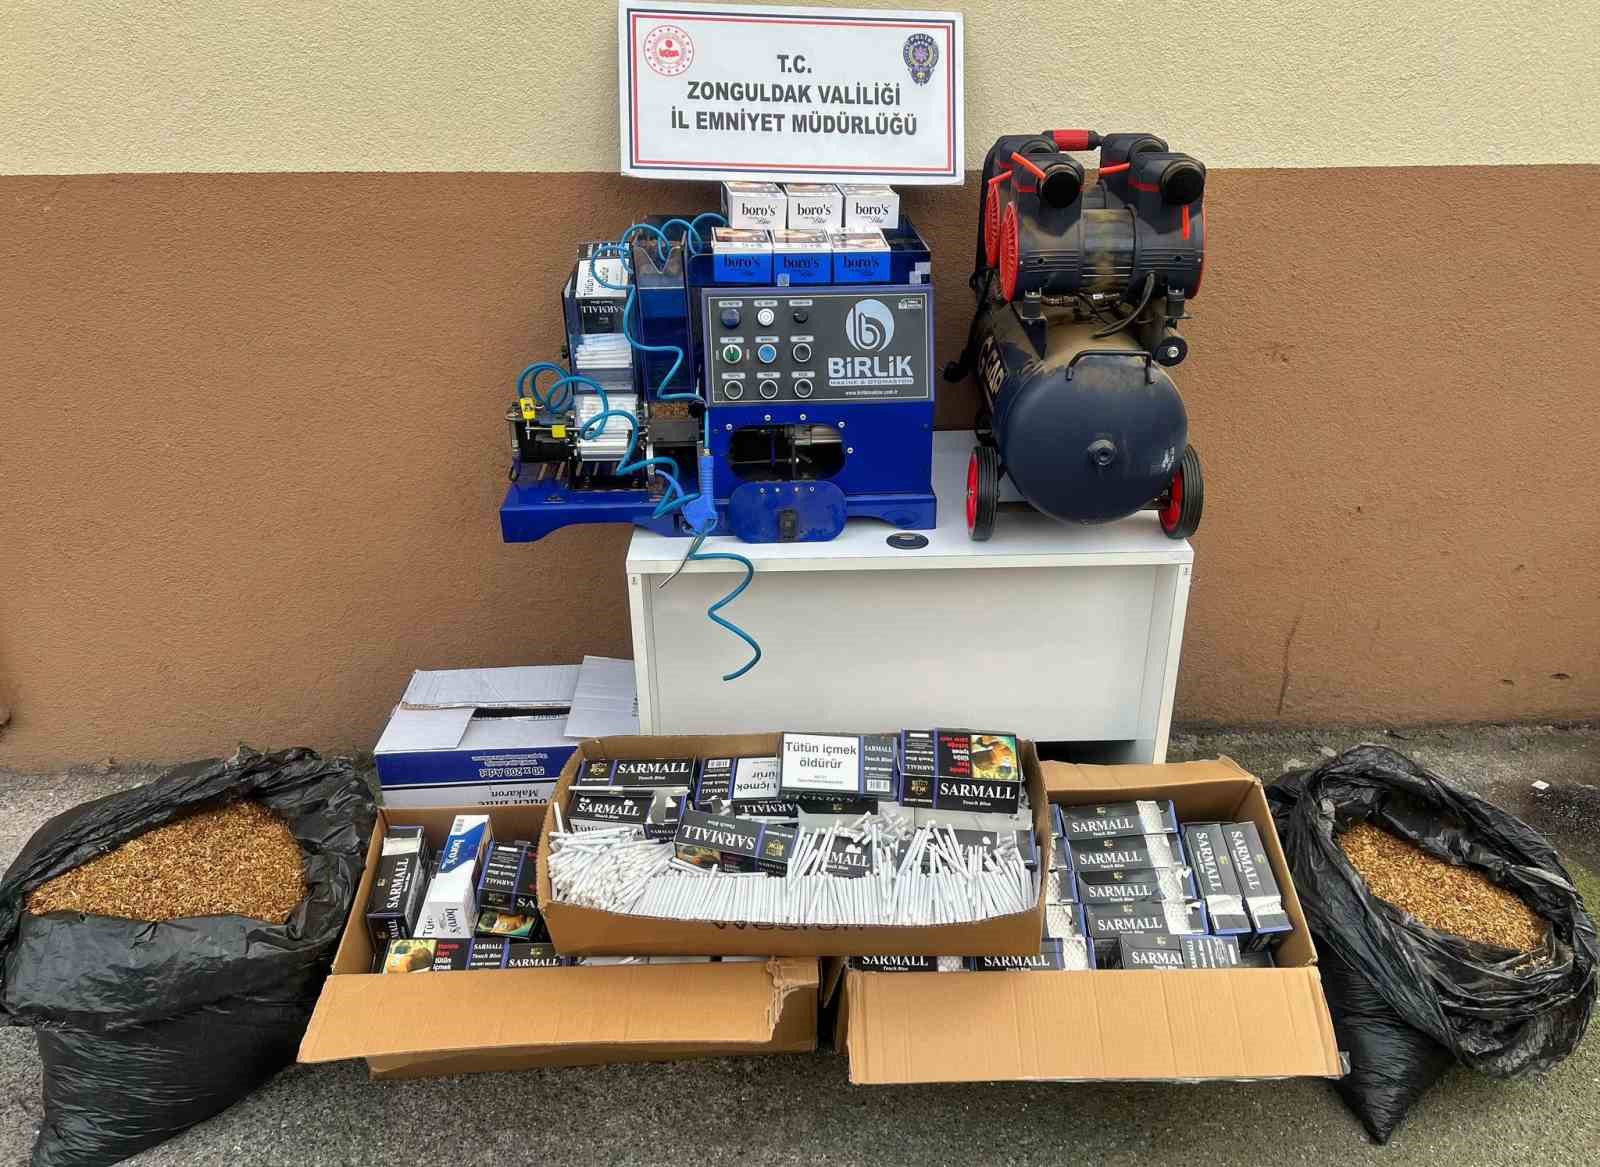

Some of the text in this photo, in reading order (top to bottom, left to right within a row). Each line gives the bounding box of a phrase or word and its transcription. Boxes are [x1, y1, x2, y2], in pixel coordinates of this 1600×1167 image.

[777, 54, 812, 74] T.C.
[687, 81, 901, 106] ZONGULDAK VALİLİĞİ
[671, 106, 917, 136] İL EMNİYET MÜDÜRLÜĞÜ
[741, 203, 776, 216] boro's
[797, 203, 831, 216] boro's
[855, 202, 889, 216] boro's
[724, 255, 761, 268] boro's
[783, 255, 820, 269] boro's
[843, 255, 880, 268] boro's
[785, 741, 857, 757] Tütün içmek
[617, 762, 689, 774] SARMALL
[799, 757, 843, 769] öldürür
[478, 768, 503, 777] Adet
[503, 767, 522, 776] 200
[490, 788, 538, 798] Makaron
[940, 782, 1016, 800] SARMALL
[577, 802, 641, 816] SARMALL
[1072, 818, 1134, 833] SARMALL
[681, 824, 756, 850] SARMALL
[832, 851, 870, 867] MALL
[1079, 851, 1143, 865] SARMALL
[1196, 832, 1223, 891] SARMALL
[1230, 830, 1261, 890] SARMALL
[386, 857, 409, 909] SARMALL
[1088, 884, 1152, 898] SARMALL
[1097, 917, 1163, 931] SARMALL
[508, 958, 560, 968] SARMALL
[862, 955, 929, 967] SARMALL
[984, 955, 1050, 967] SARMALL
